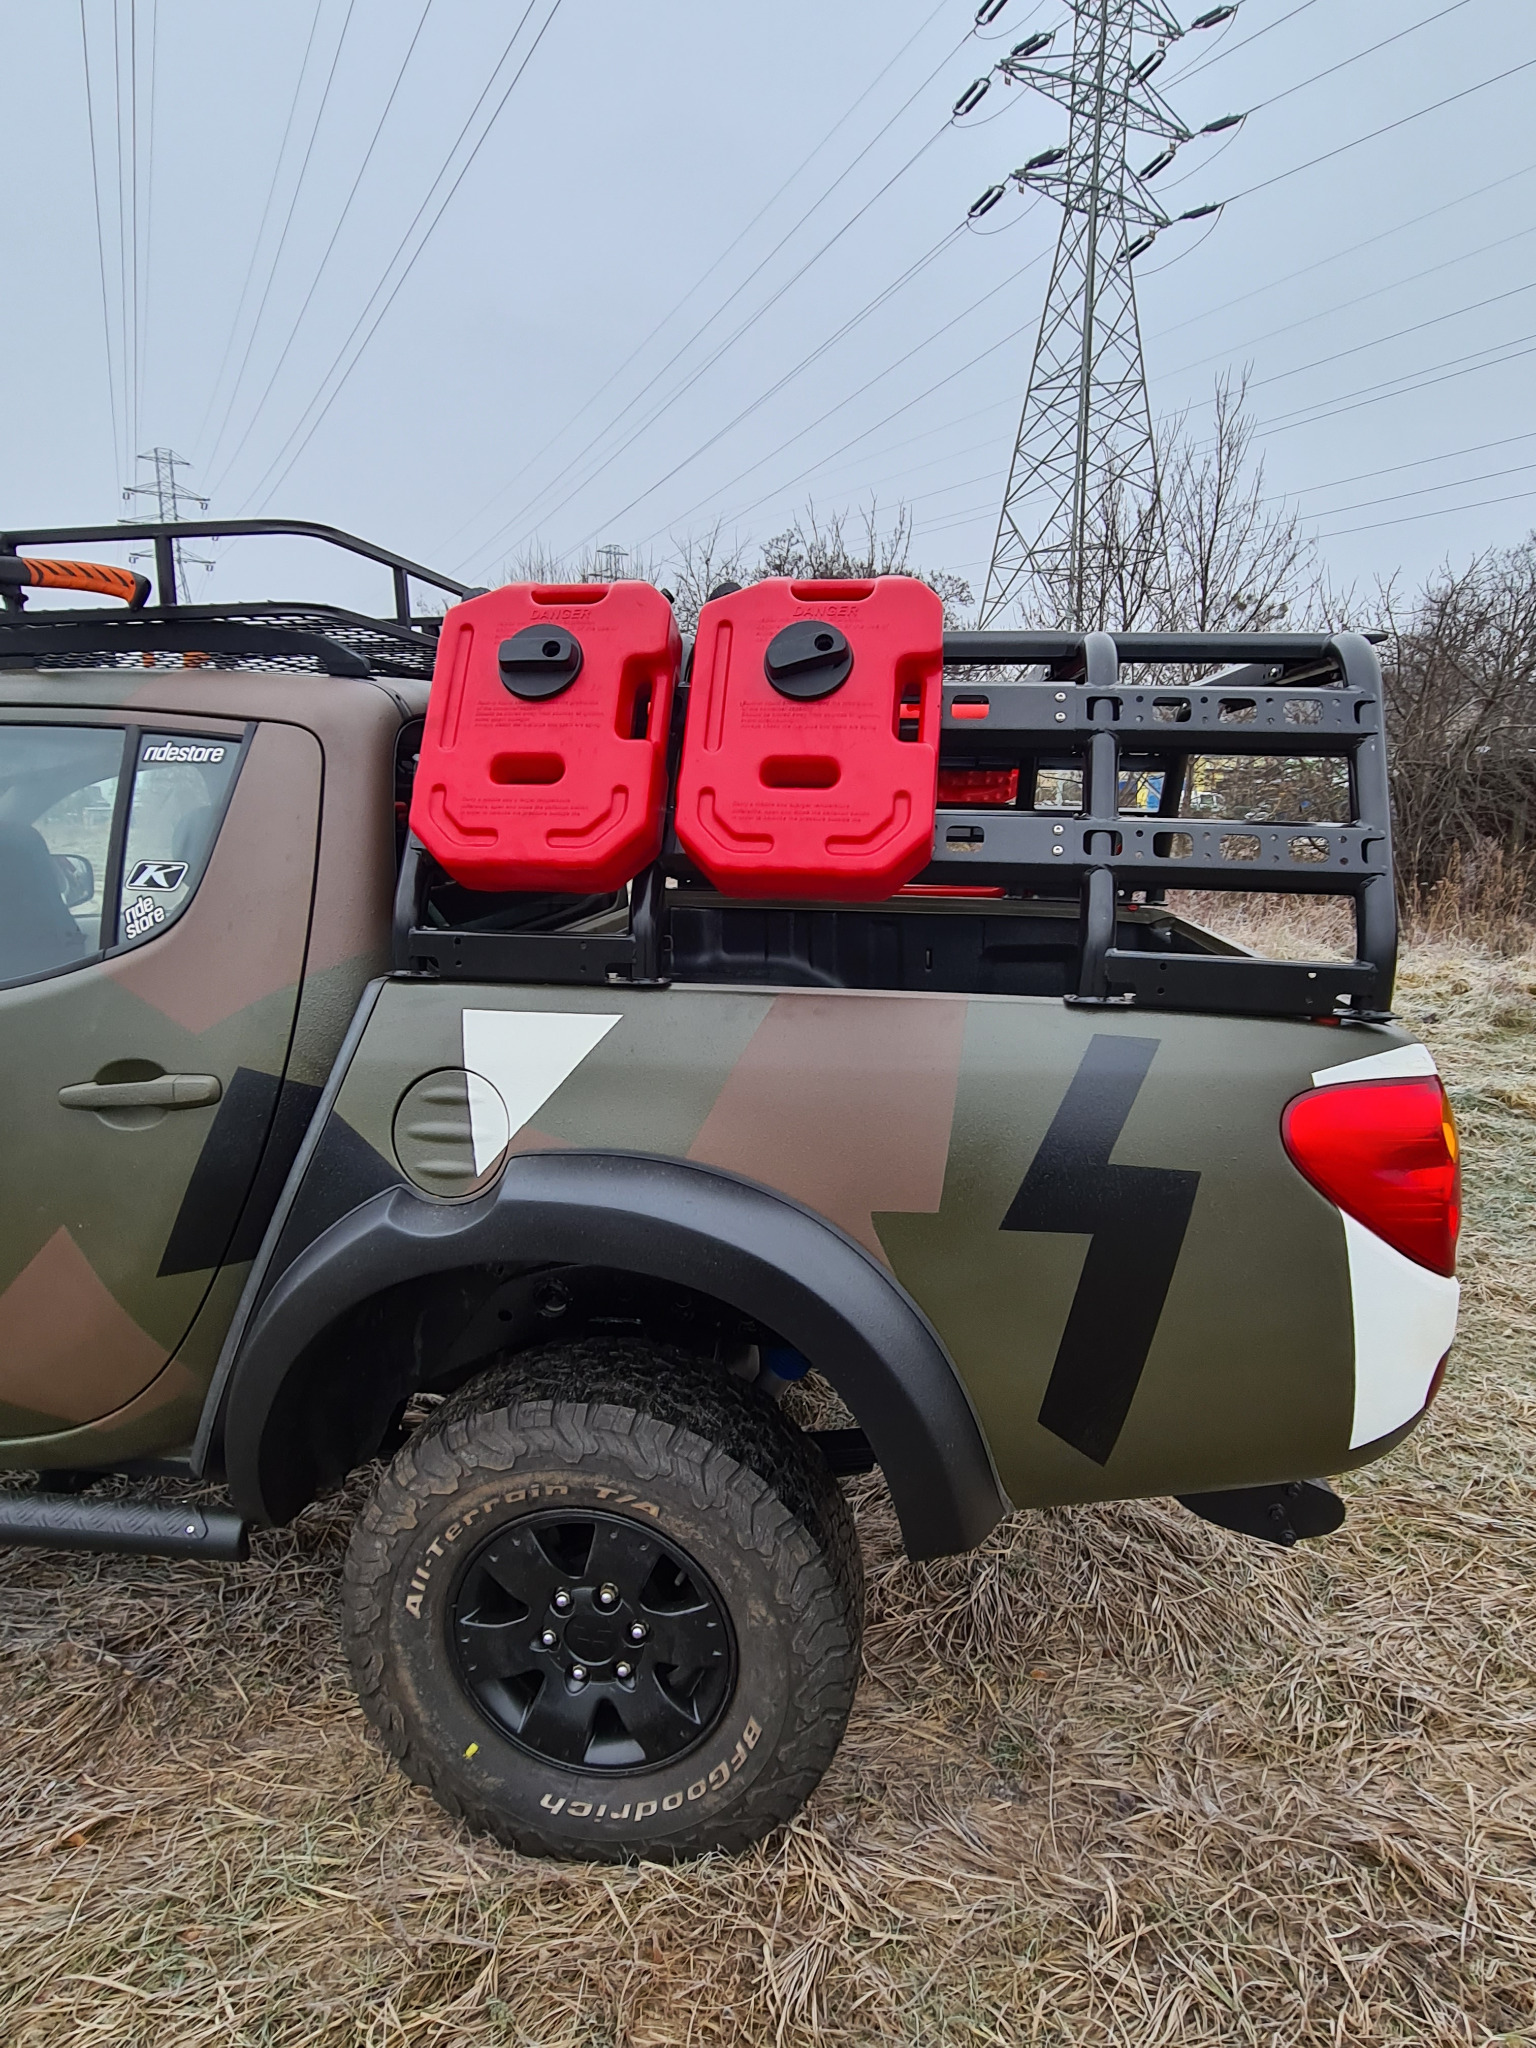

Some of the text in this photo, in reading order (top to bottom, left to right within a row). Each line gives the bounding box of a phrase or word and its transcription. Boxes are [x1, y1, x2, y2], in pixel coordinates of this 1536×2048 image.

[530, 609, 592, 620] DANGER
[792, 606, 859, 617] DANGER
[143, 742, 225, 762] ridestore
[128, 864, 184, 888] K
[125, 896, 154, 924] ride
[126, 907, 165, 939] store
[404, 1483, 662, 1619] All-Terrain T/A
[539, 1716, 763, 1823] BFGoodrich
